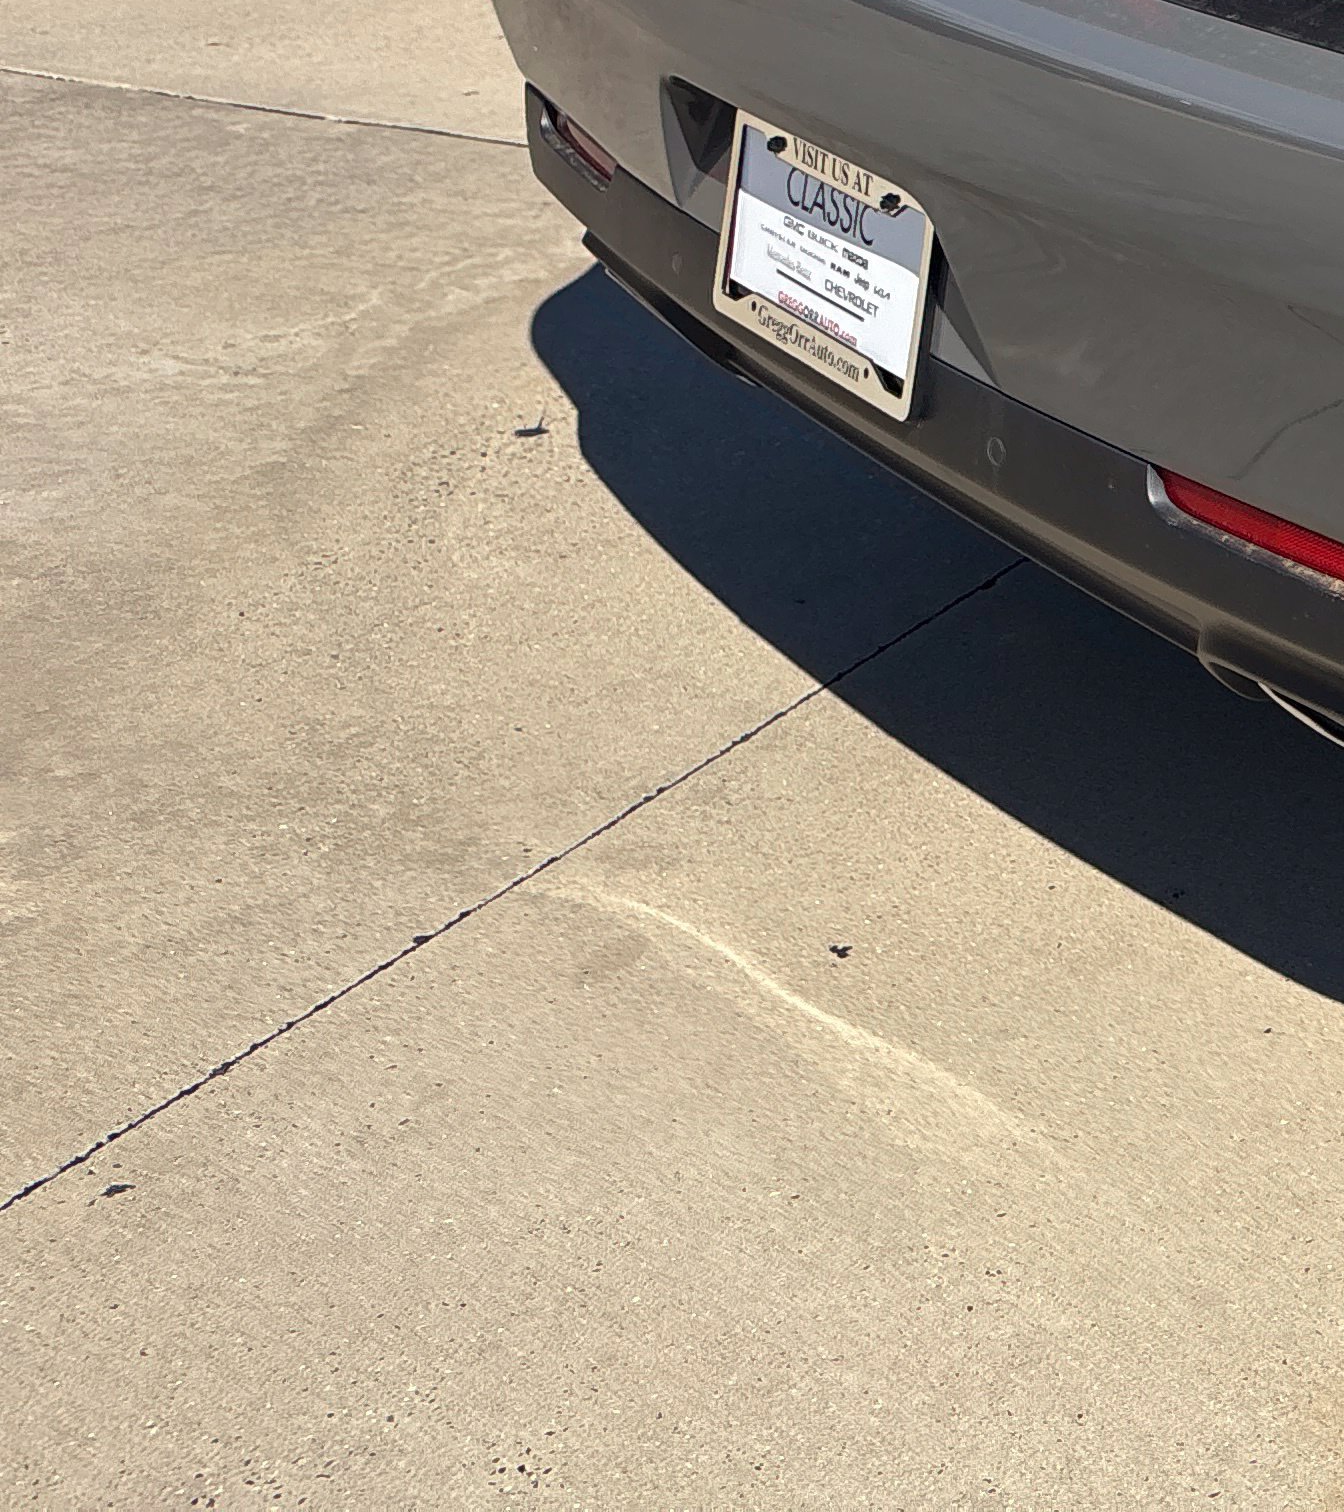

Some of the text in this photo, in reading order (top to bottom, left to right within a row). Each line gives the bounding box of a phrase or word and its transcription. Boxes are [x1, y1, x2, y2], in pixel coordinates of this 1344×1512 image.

[793, 136, 873, 197] VISIT US AT
[787, 168, 874, 246] CLASSIC
[825, 278, 879, 318] CHEVROLET
[830, 262, 850, 278] RAM
[757, 304, 860, 382] GreggOrrAuto.com
